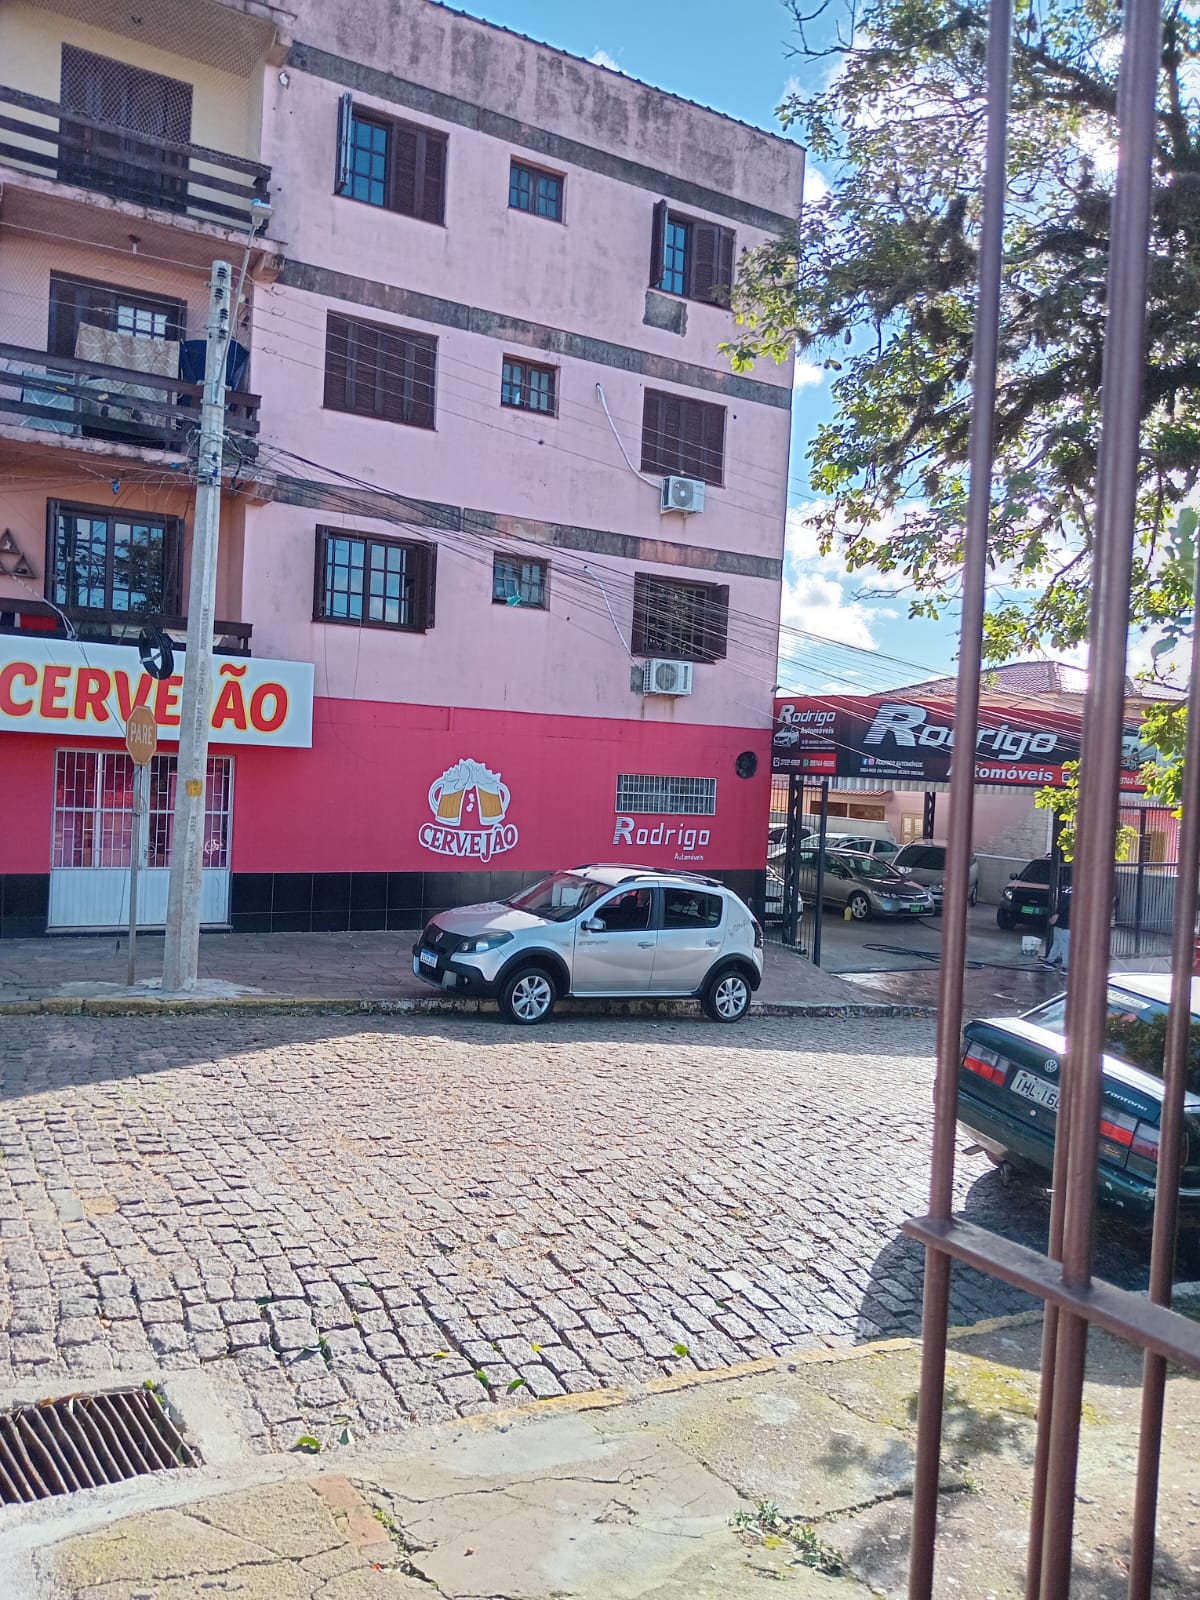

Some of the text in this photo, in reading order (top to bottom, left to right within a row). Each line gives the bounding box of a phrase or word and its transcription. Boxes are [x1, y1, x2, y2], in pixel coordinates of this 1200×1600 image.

[0, 661, 289, 733] CERVEÃO
[776, 704, 836, 727] Rodrigo
[863, 703, 1058, 760] Rorigo
[130, 721, 153, 745] PARE
[946, 764, 1053, 782] tomóveis
[419, 823, 518, 862] CERVEJÃO
[612, 816, 711, 850] Rodrigo
